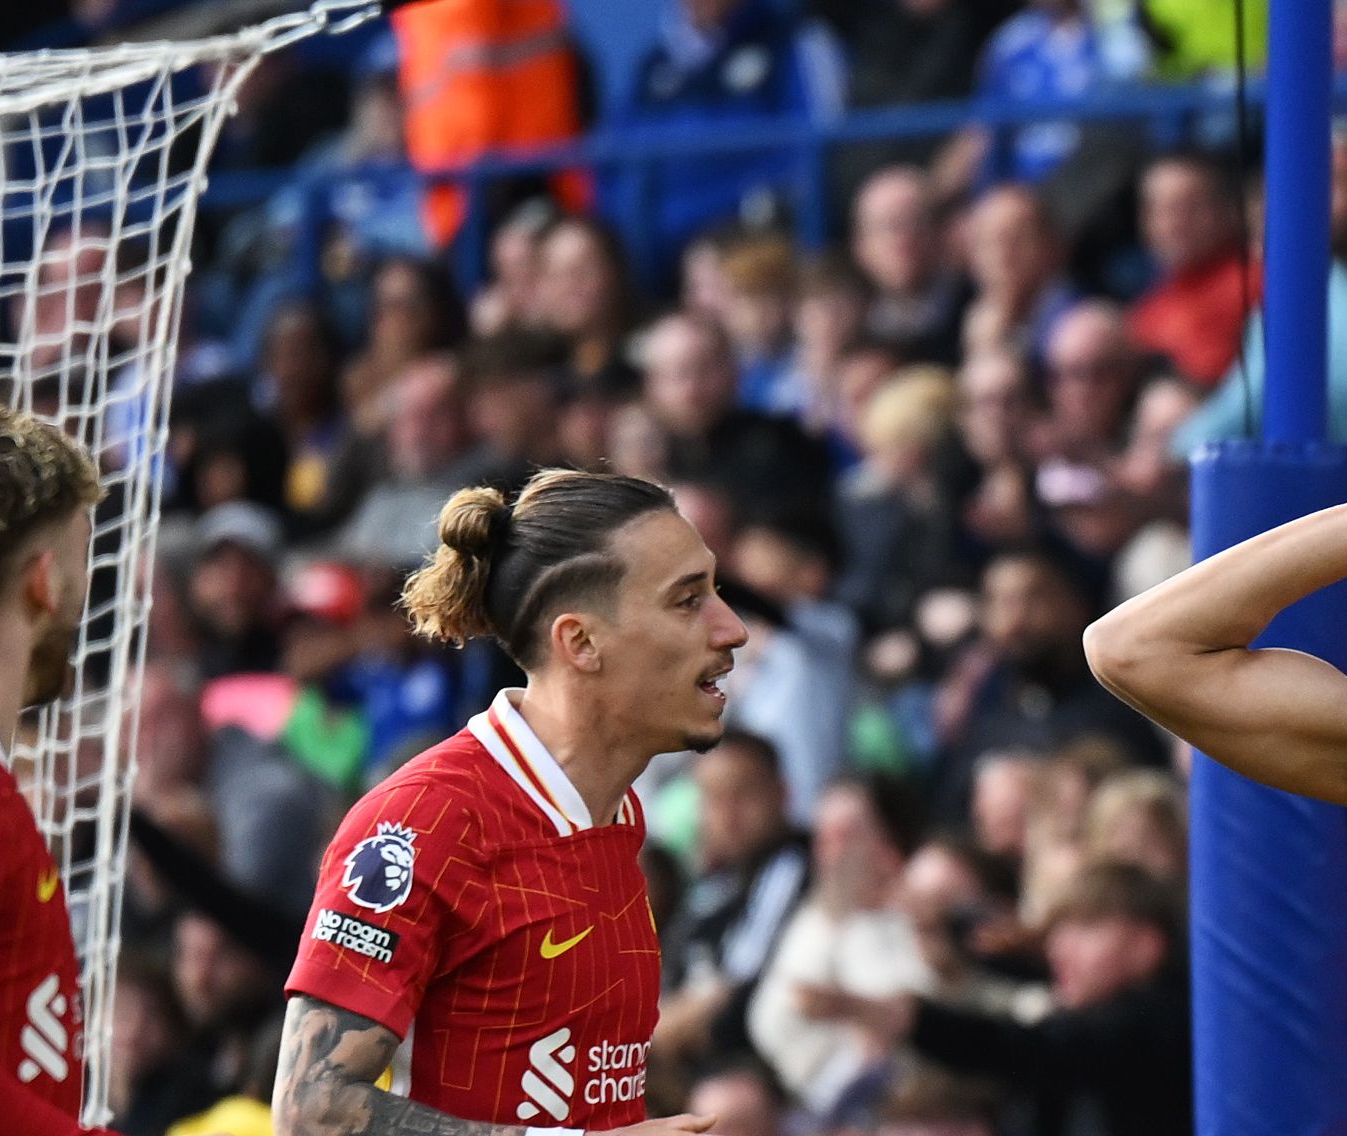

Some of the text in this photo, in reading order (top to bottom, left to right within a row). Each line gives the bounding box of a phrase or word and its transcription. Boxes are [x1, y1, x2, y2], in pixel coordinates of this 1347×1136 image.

[317, 908, 391, 947] No room
[336, 931, 393, 964] racism
